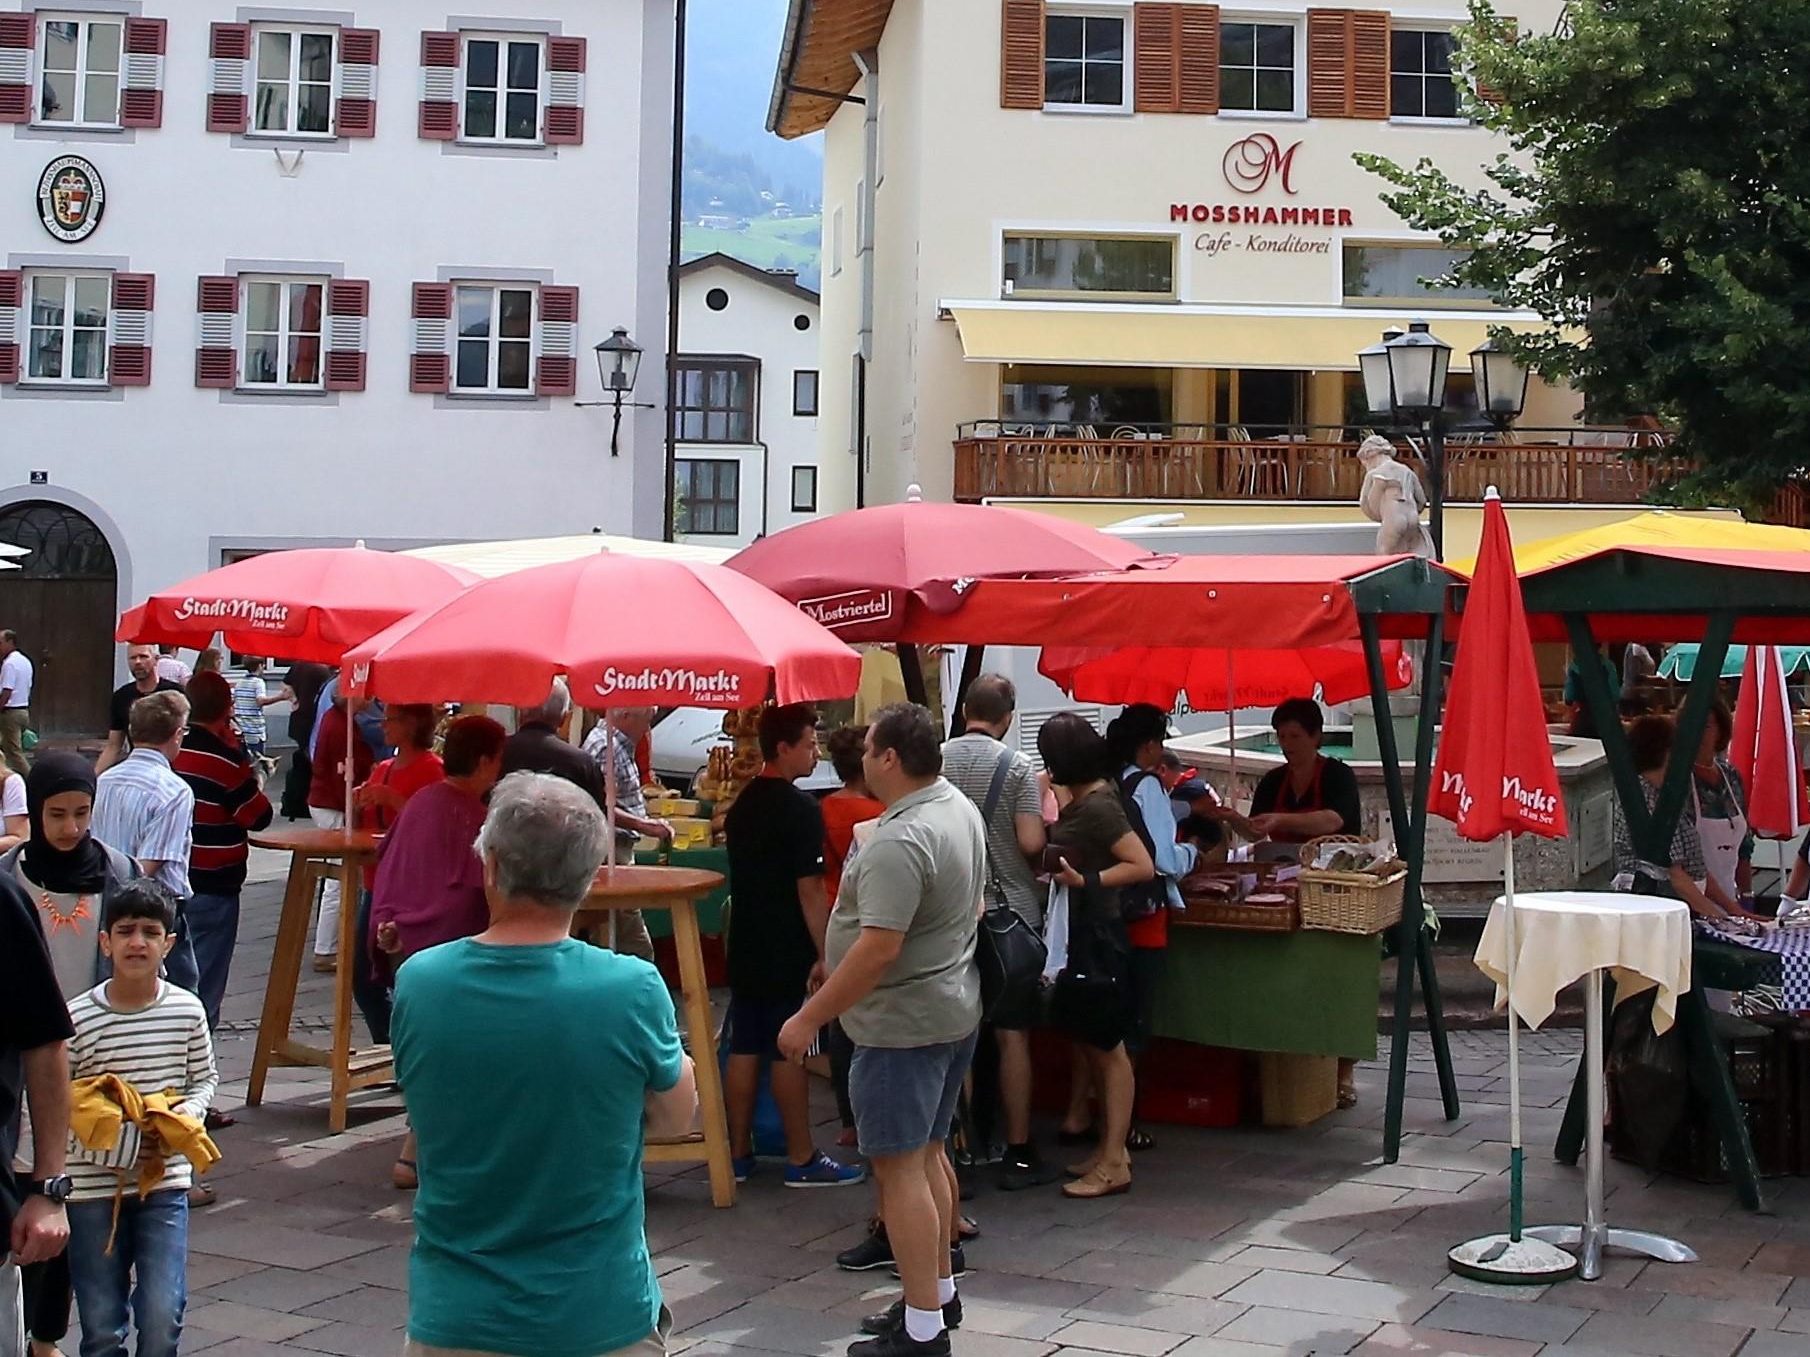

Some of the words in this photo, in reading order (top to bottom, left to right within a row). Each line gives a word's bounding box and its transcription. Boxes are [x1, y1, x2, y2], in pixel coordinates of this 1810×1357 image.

[1222, 132, 1303, 194] M
[1170, 203, 1353, 227] MOSSHAMMER
[1194, 232, 1231, 257] Cafe
[1245, 234, 1332, 254] Konditorei
[804, 593, 886, 623] Mostviertel
[695, 692, 711, 702] Zell
[712, 694, 724, 702] am
[725, 693, 740, 702] See
